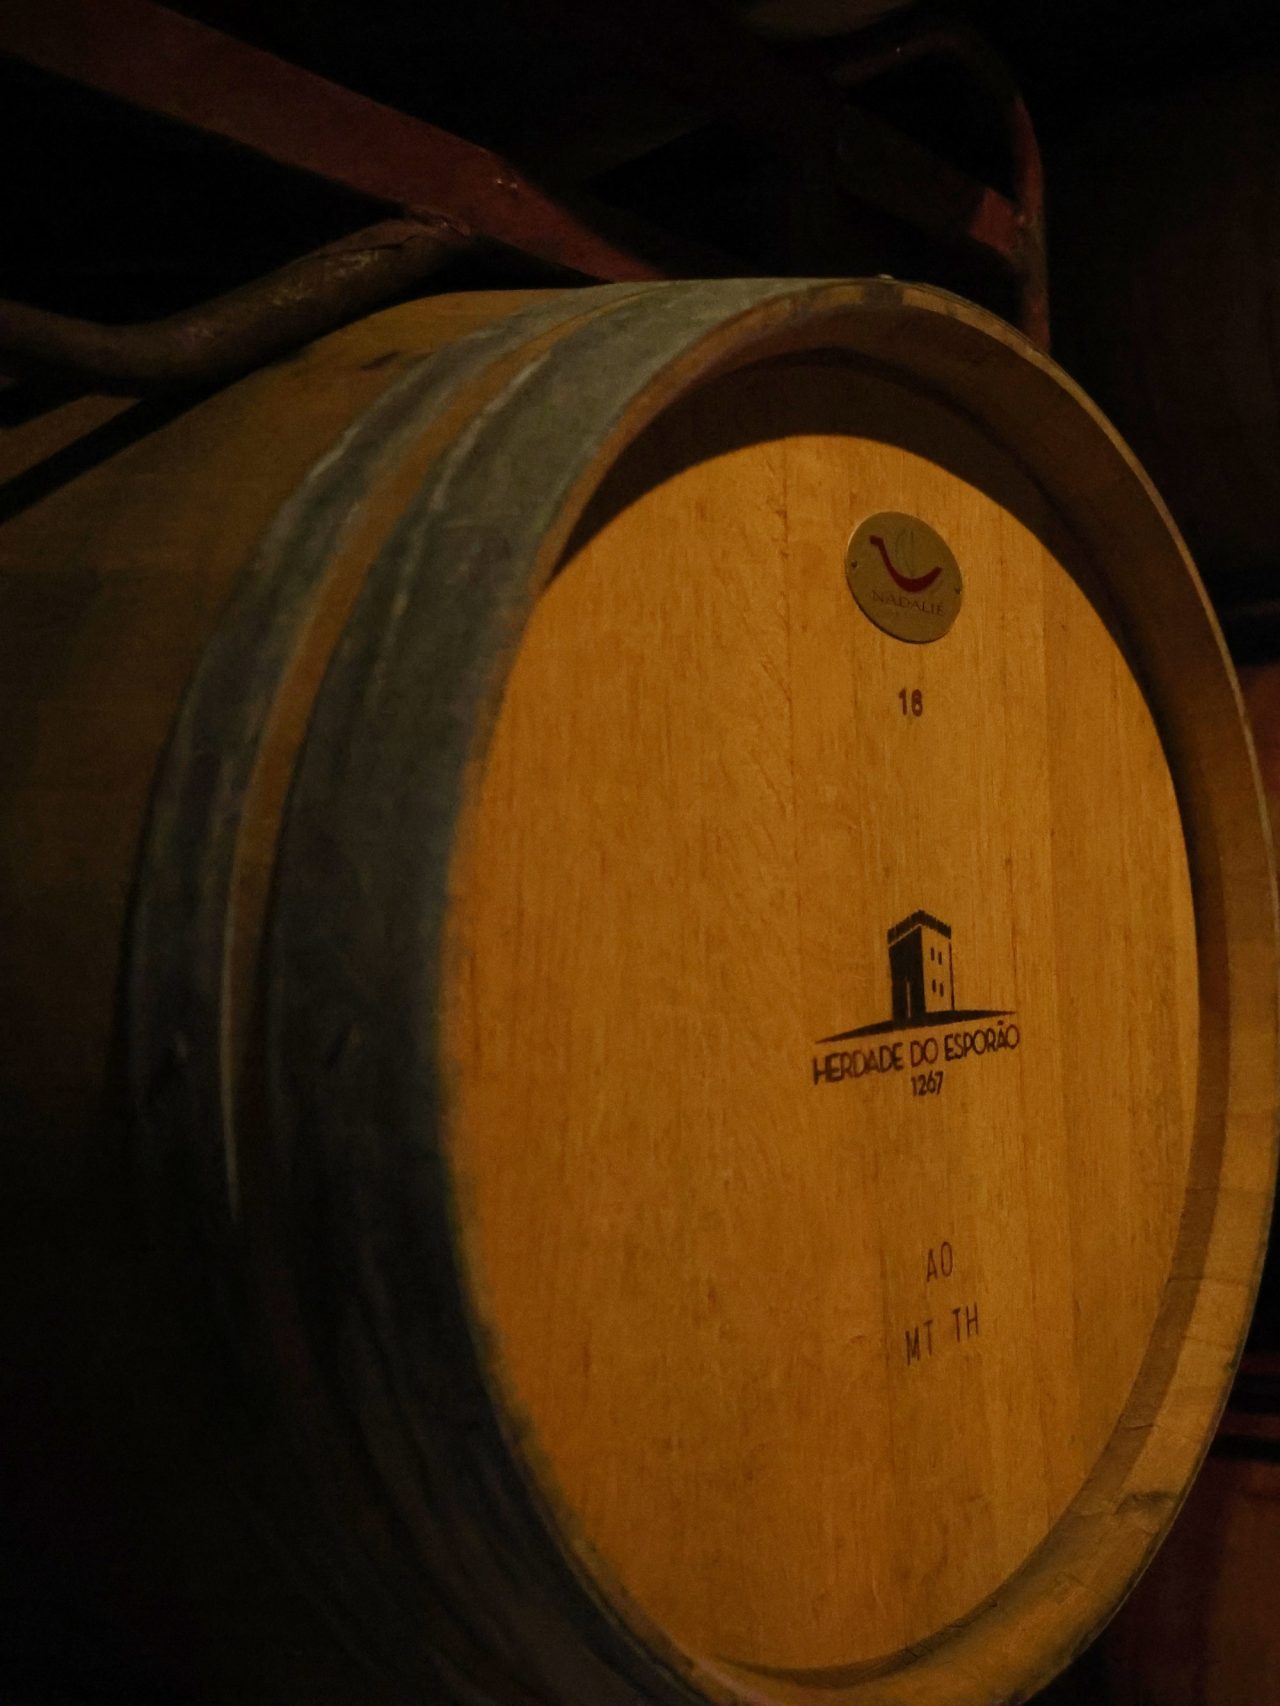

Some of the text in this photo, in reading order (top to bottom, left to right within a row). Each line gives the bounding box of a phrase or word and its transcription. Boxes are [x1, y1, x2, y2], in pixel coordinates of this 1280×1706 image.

[898, 688, 923, 717] 18
[812, 1020, 1020, 1085] HERDADE DO ESPORÃO
[910, 1071, 943, 1096] 1267
[905, 1302, 978, 1366] MT TH
